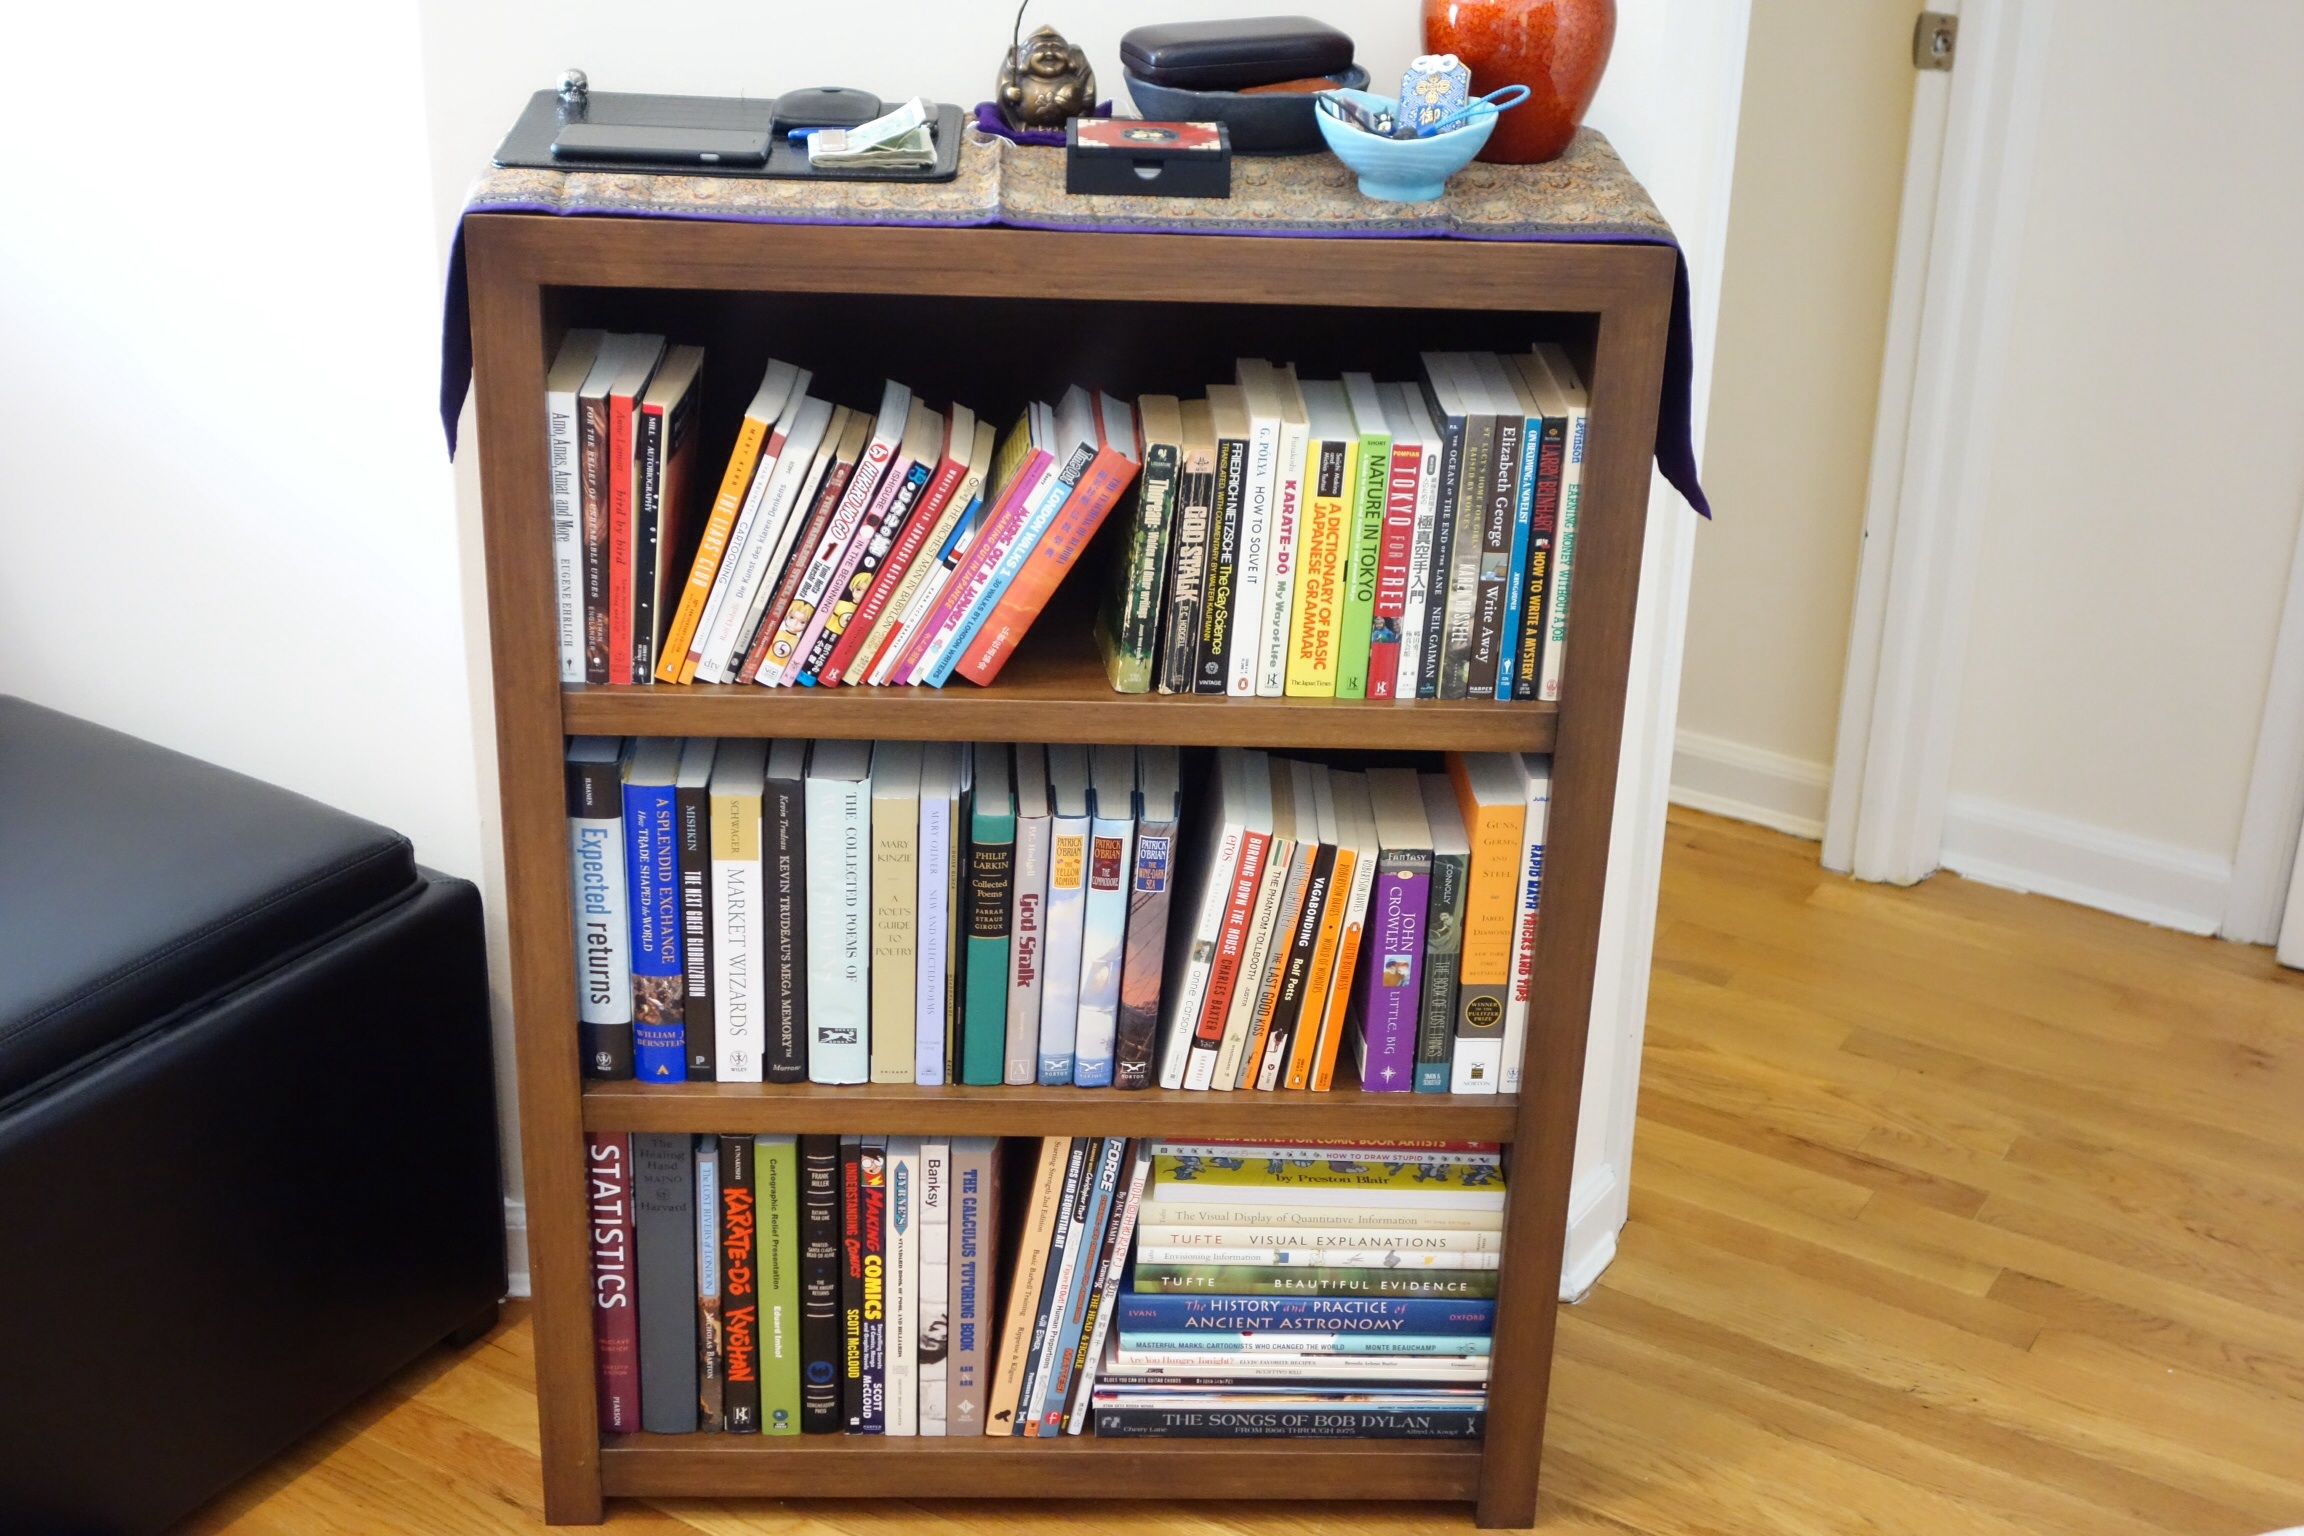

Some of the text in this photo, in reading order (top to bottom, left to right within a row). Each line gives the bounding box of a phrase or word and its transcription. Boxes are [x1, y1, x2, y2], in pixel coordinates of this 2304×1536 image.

[1259, 427, 1270, 438] G.
[1393, 450, 1420, 458] POMPIAN
[549, 411, 573, 541] Amo, Amas, Amat and More
[644, 446, 654, 511] AUTOBIOGRAPHY
[830, 461, 878, 540] HIKARU NO GO
[1488, 427, 1515, 546] Elizabeth George
[718, 522, 747, 583] CARTOONING
[1175, 505, 1206, 603] GOD STALK
[1211, 442, 1242, 654] FRIEDRICH NIETZSCHE The Gay Science
[1247, 486, 1264, 584] HOW TO SOLVE IT
[1357, 455, 1385, 601] NATURE IN TOKYO
[1379, 467, 1415, 608] TOKYO FOR FREE
[560, 558, 572, 646] EUGENE EHRLICH
[1275, 580, 1286, 599] My
[1300, 503, 1325, 658] JAPANESE GRAMMAR
[1313, 503, 1341, 669] A DICTIONARY OF BASIC
[1272, 601, 1284, 627] Way
[1475, 586, 1498, 662] Write Away
[1269, 643, 1280, 667] Life
[686, 805, 696, 850] MISHKIN
[730, 800, 739, 852] SCHWAGER
[1096, 837, 1121, 848] PATRICK
[1142, 839, 1167, 850] PATRICK
[655, 798, 674, 962] A SPLENDID EXCHANGE
[779, 855, 789, 892] KEVIN
[973, 861, 1009, 870] LARKIN
[976, 851, 1007, 860] PHILIP
[845, 792, 857, 983] THE COLLECTED POEMS OF
[972, 879, 1008, 889] Collected
[977, 889, 1003, 898] Poems
[1223, 837, 1261, 955] BURNING DOWN THE HOUSE
[577, 827, 611, 1003] Expected returns
[779, 896, 790, 960] TRUDEAU'S
[1017, 893, 1038, 986] God Stalk
[1284, 877, 1324, 1000] VAGABONDING Rolf Potts
[1385, 886, 1401, 951] CROWLEY
[1400, 913, 1415, 951] JOHN
[1514, 844, 1544, 1003] RAPID MATH TRICKS AND TIPS
[727, 869, 746, 1035] MARKET WIZARDS
[780, 963, 791, 996] MEGA
[1179, 970, 1200, 1033] anne carson
[1383, 1036, 1395, 1054] BIG
[769, 1158, 777, 1210] Cartographic
[925, 1159, 940, 1207] Banksy
[1100, 1139, 1121, 1191] FORCE
[1275, 1174, 1391, 1184] by Preston Blair
[844, 1163, 860, 1278] UNDERSTANDING COMICS
[895, 1171, 906, 1224] BYRNE'S
[1175, 1211, 1195, 1221] The
[1199, 1211, 1229, 1221] Visual
[1234, 1212, 1273, 1224] Display
[1276, 1212, 1288, 1222] of
[1291, 1213, 1354, 1225] Quantitative
[1358, 1214, 1418, 1225] Information
[592, 1145, 625, 1307] STATISTICS
[1170, 1234, 1447, 1248] TUFTE VISUAL EXPLANATIONS
[771, 1239, 779, 1289] Presentation
[864, 1188, 882, 1319] MAKING COMICS
[959, 1169, 977, 1351] THE CALCULUS TUTORING BOOK
[1161, 1277, 1468, 1292] TUFTE BEAUTIFUL EVIDENCE
[1185, 1301, 1207, 1312] The
[1210, 1300, 1280, 1312] HISTORY
[1283, 1302, 1308, 1313] and
[1313, 1301, 1388, 1314] PRACTICE
[773, 1305, 782, 1358] Eduard Imhof
[847, 1309, 859, 1377] SCOTT McCLOUD
[1185, 1317, 1405, 1330] ANCIENT ASTRONOMY
[1449, 1314, 1486, 1322] OXFORD
[612, 1396, 620, 1425] PEARSON
[862, 1375, 871, 1418] McCLOUD
[872, 1383, 882, 1411] SCOTT
[1161, 1414, 1431, 1429] THE SONGS OF BOB DYLAN
